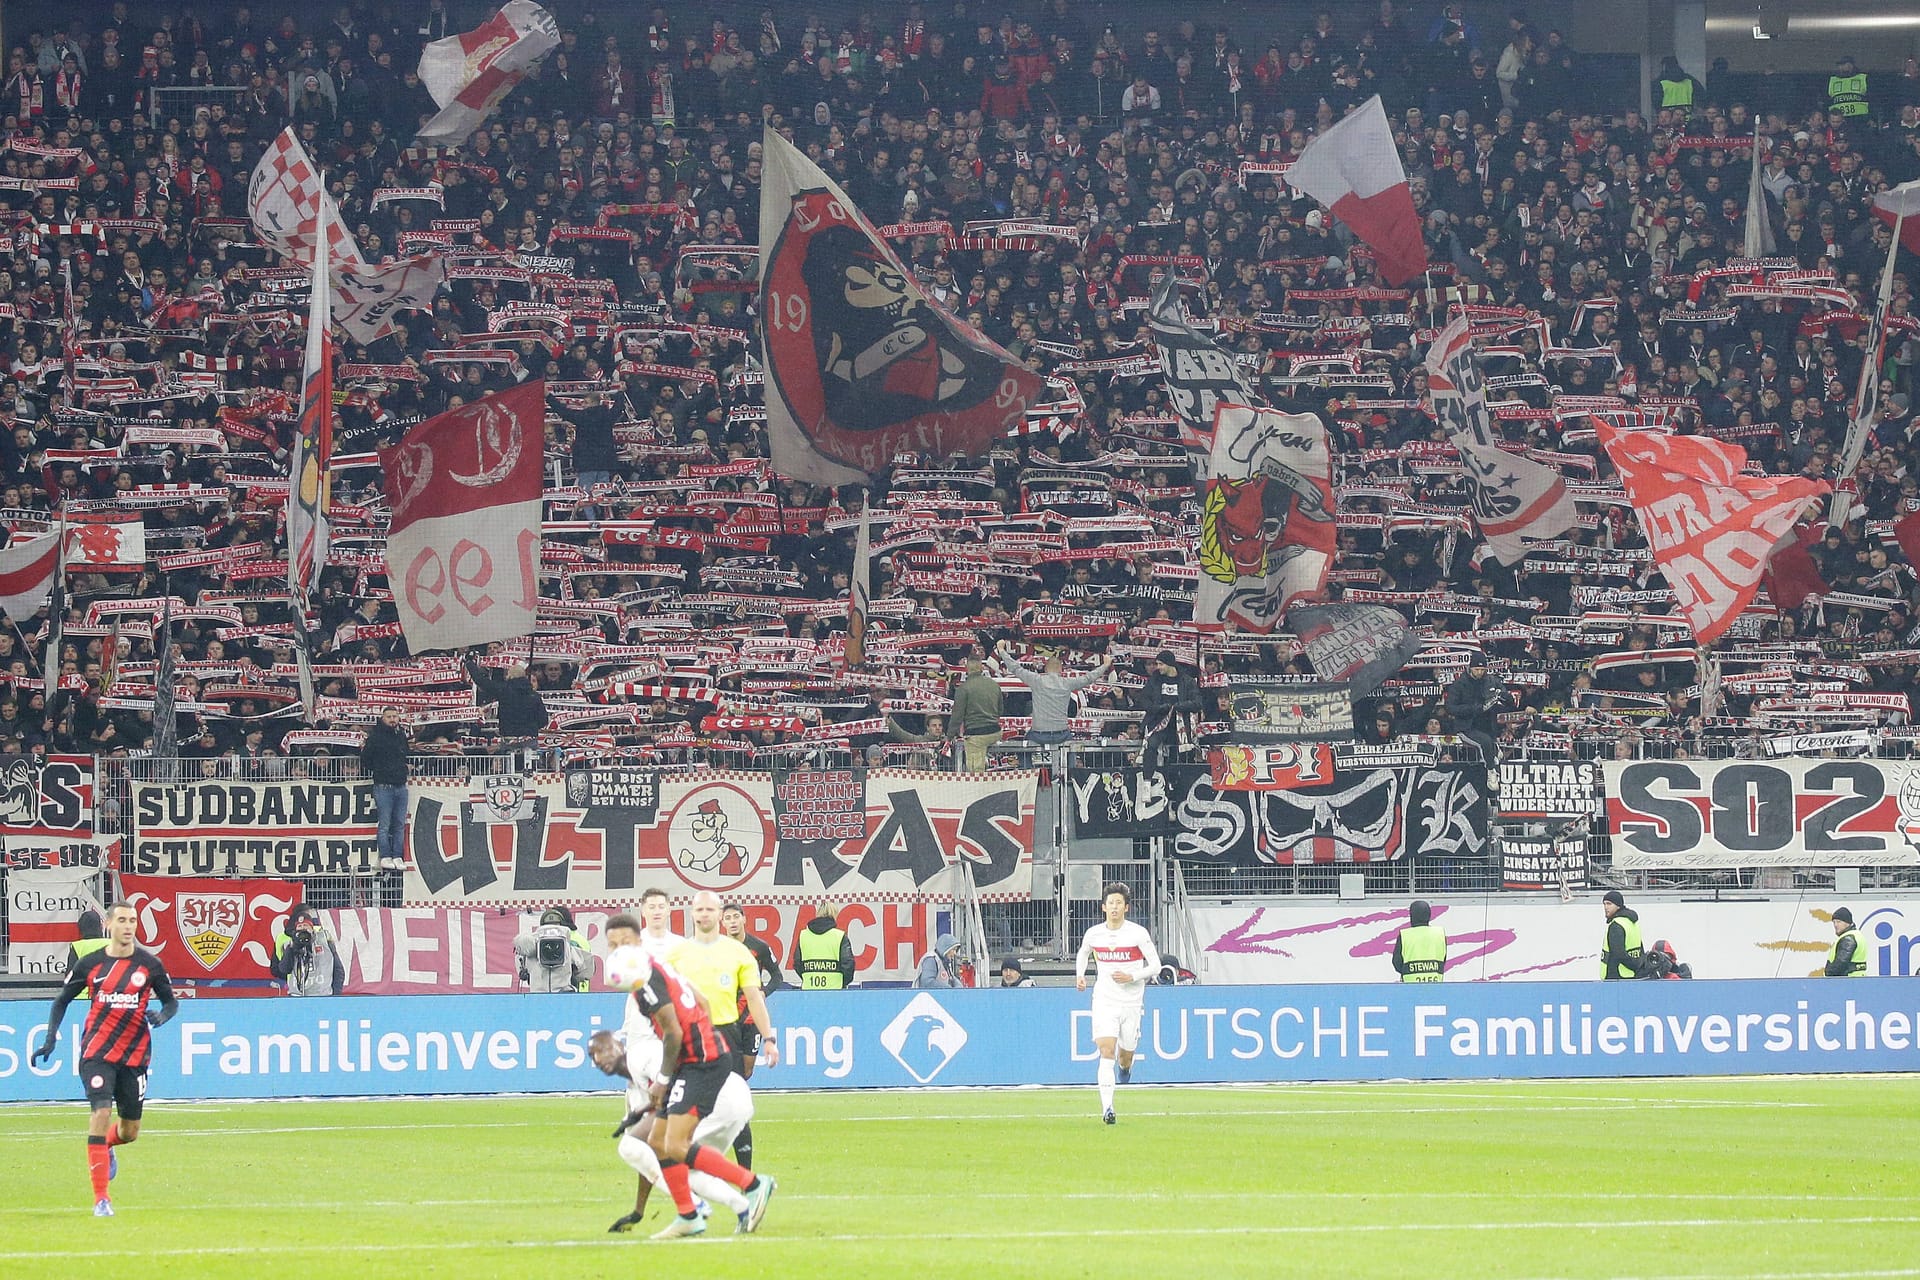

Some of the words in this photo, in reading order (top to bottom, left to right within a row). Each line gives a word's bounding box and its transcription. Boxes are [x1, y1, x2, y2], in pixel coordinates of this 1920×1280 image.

[642, 505, 669, 515] CC
[720, 521, 782, 536] Command
[1153, 563, 1200, 576] CANNSTAT
[1424, 654, 1453, 664] WEISS
[1751, 653, 1781, 662] WEISS
[716, 717, 744, 728] CC
[769, 717, 796, 729] 97
[591, 772, 614, 784] DU
[619, 772, 654, 785] BIST
[786, 770, 853, 785] JEDER
[1499, 763, 1595, 785] ULTRAS
[488, 777, 521, 789] SSV
[591, 783, 654, 798] IMMER
[777, 782, 863, 800] VERBANNTE
[1499, 782, 1595, 799] BEDEUTET
[137, 783, 378, 827] SÜDBANDE
[591, 795, 612, 808] BEI
[786, 799, 856, 813] KEHRT
[1501, 840, 1551, 856] KAMPF
[136, 839, 378, 876] STUTTGART
[1503, 855, 1559, 870] EINSATZ
[1560, 853, 1585, 868] FÜR
[1503, 869, 1541, 882] UNSERE
[1408, 961, 1440, 973] STEWAR
[808, 974, 828, 988] 108
[1069, 1005, 1390, 1063] DUTSCHE
[1413, 998, 1920, 1058] Familienversiche
